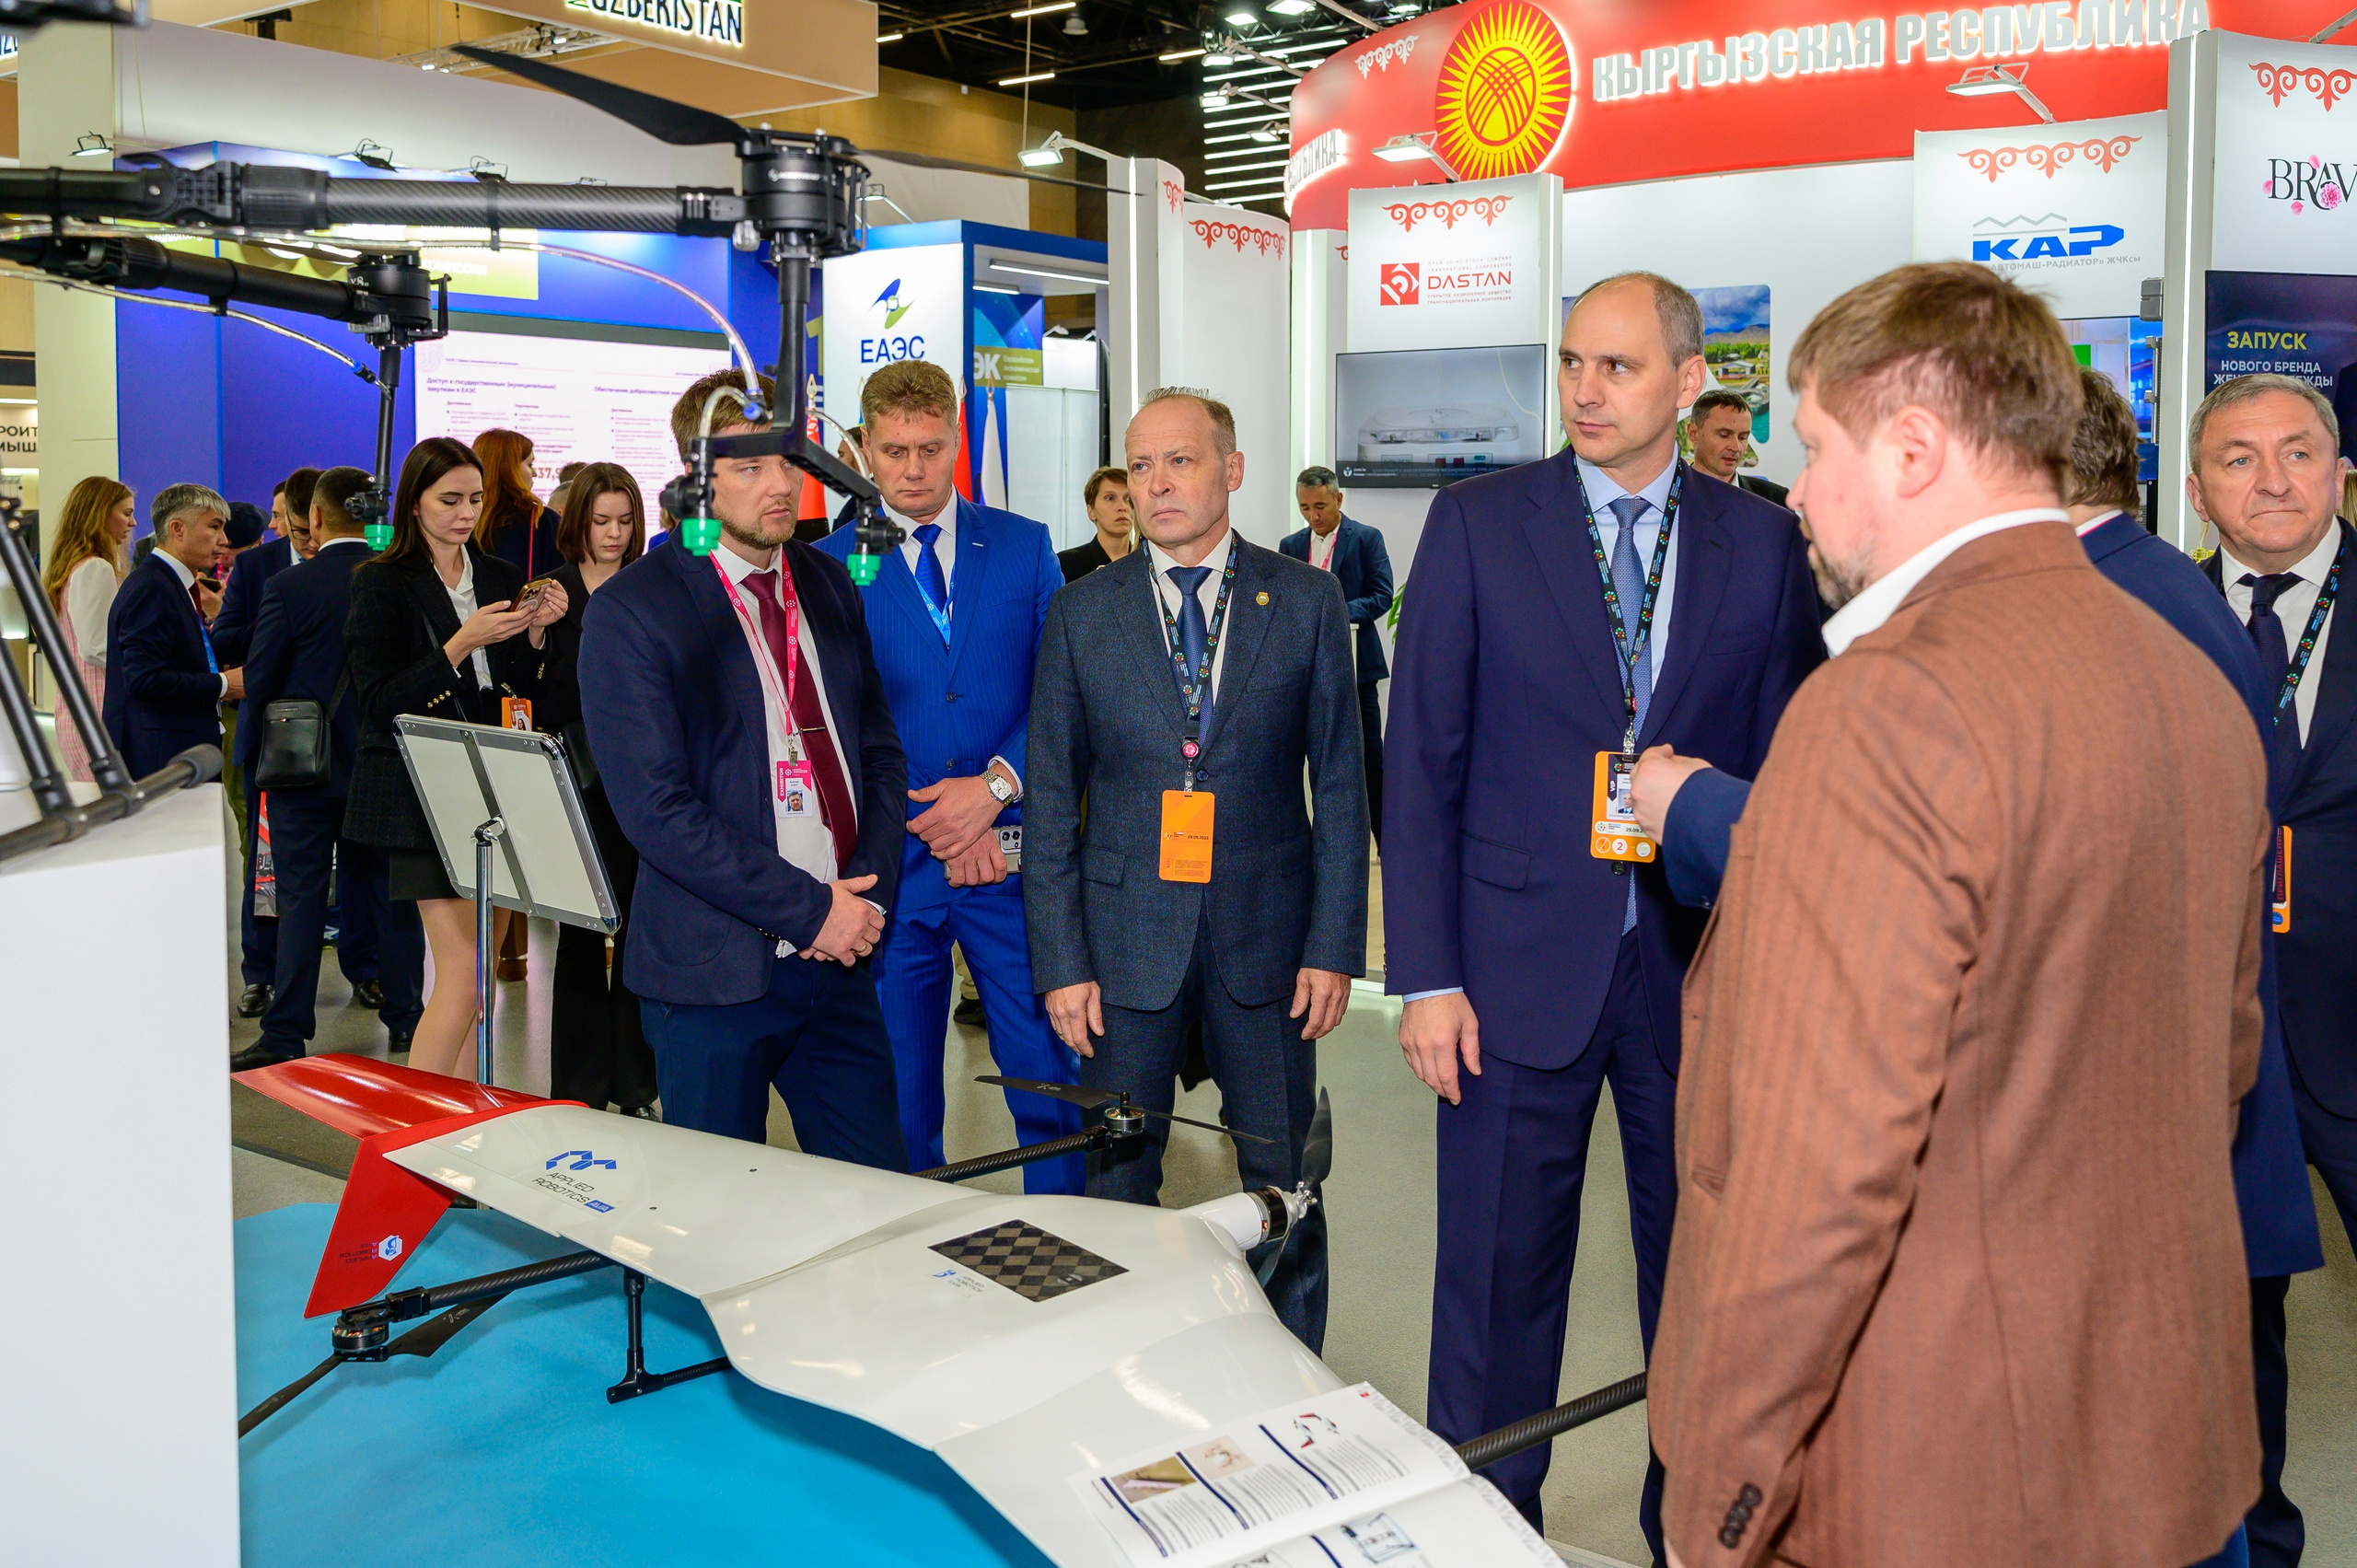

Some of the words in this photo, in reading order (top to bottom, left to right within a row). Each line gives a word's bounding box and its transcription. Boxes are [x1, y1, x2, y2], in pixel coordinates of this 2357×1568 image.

[1593, 18, 1884, 101] КЫРГЫЗСКАЯ
[1896, 0, 2212, 64] РЕСПУБЛИКА
[2107, 255, 2141, 265] ЖЧКсы
[1427, 270, 1512, 290] DASTAN
[860, 336, 925, 364] ЕАЭС
[2226, 331, 2307, 351] ЗАПУСК
[2221, 360, 2271, 372] НОВОГО
[2274, 362, 2322, 374] БРЕНДА
[2292, 376, 2333, 388] ЕЖДЫ
[1617, 842, 1623, 851] 2
[532, 1177, 590, 1203] ROBOTICS
[546, 1172, 595, 1193] APPLIED
